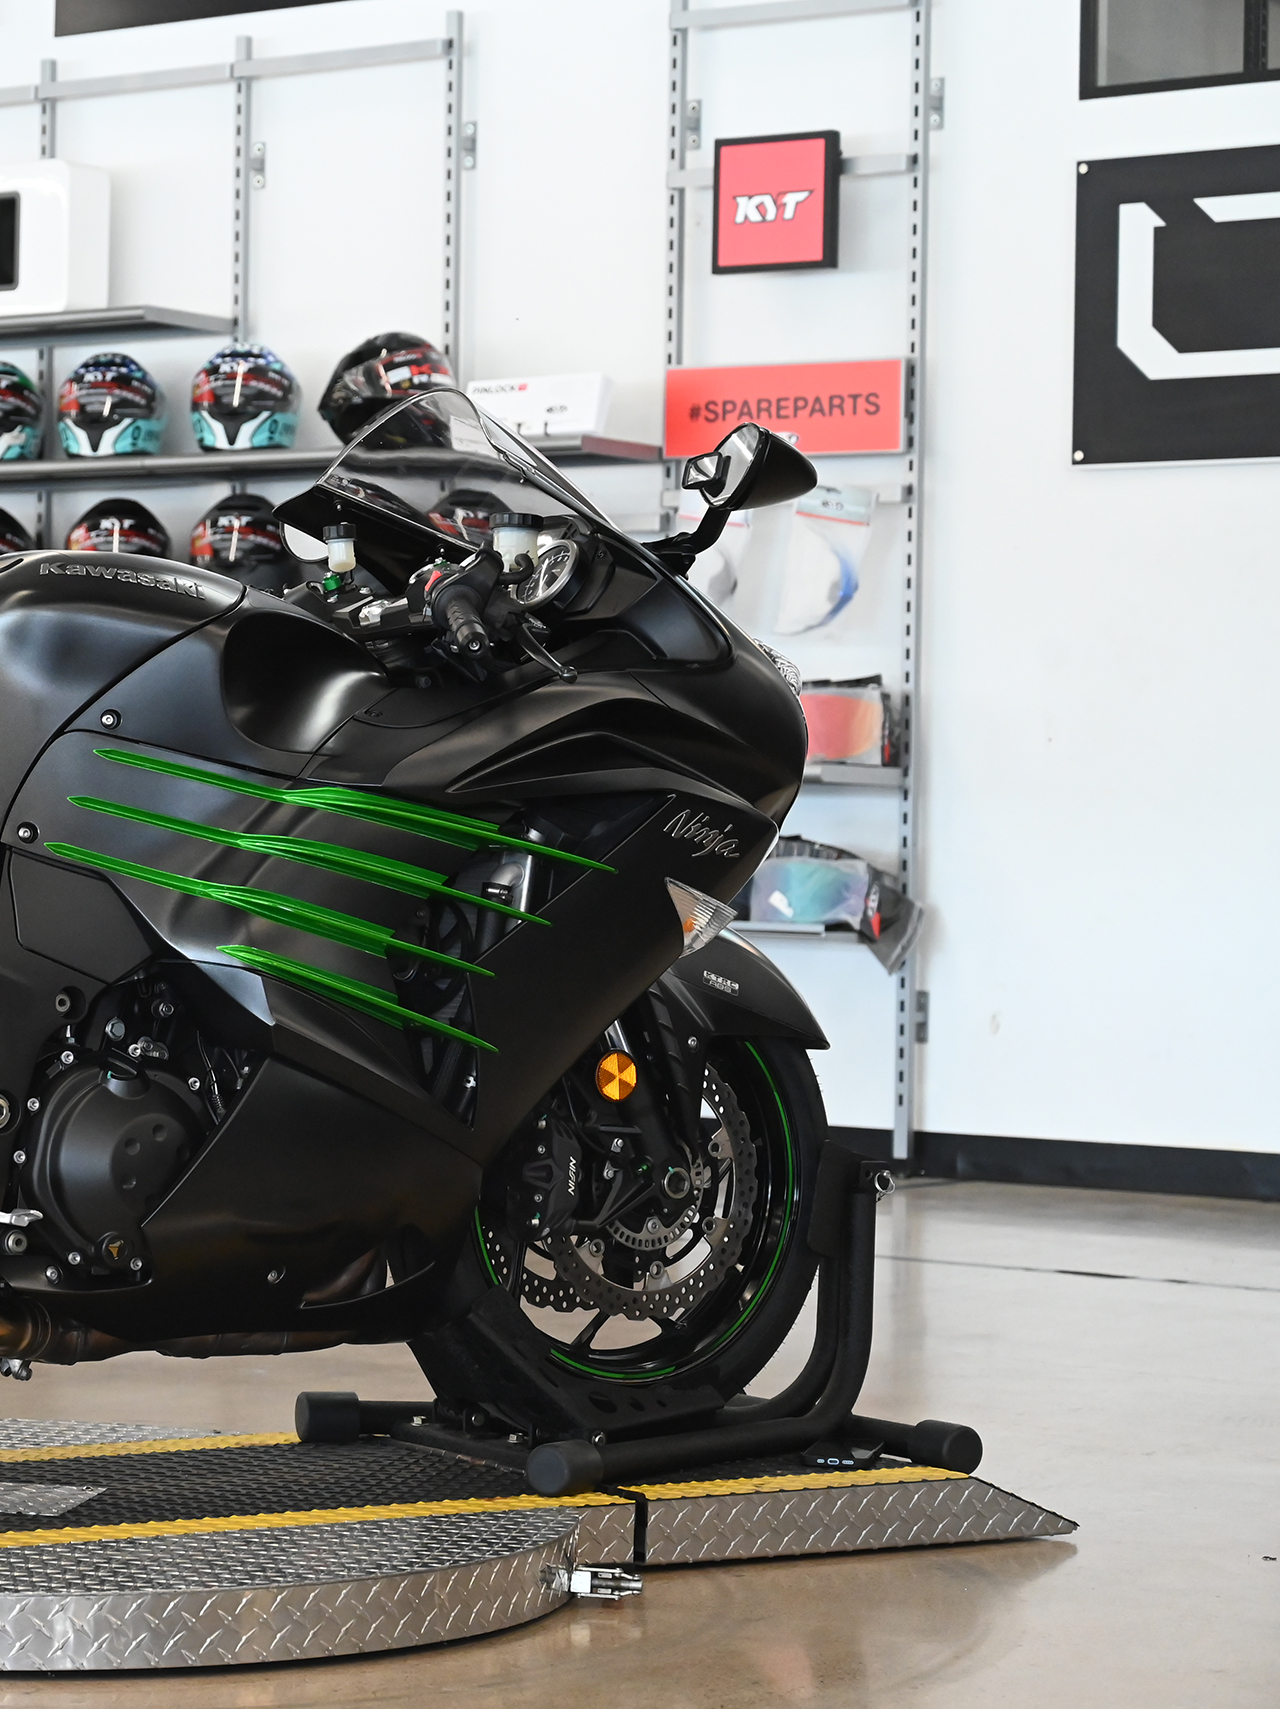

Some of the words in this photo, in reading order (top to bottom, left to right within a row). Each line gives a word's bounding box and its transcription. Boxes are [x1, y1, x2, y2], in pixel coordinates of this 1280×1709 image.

[732, 189, 815, 225] KYT
[689, 392, 882, 423] #SPAREPARTS
[39, 561, 206, 600] Kawasaki
[663, 808, 740, 858] Ninja
